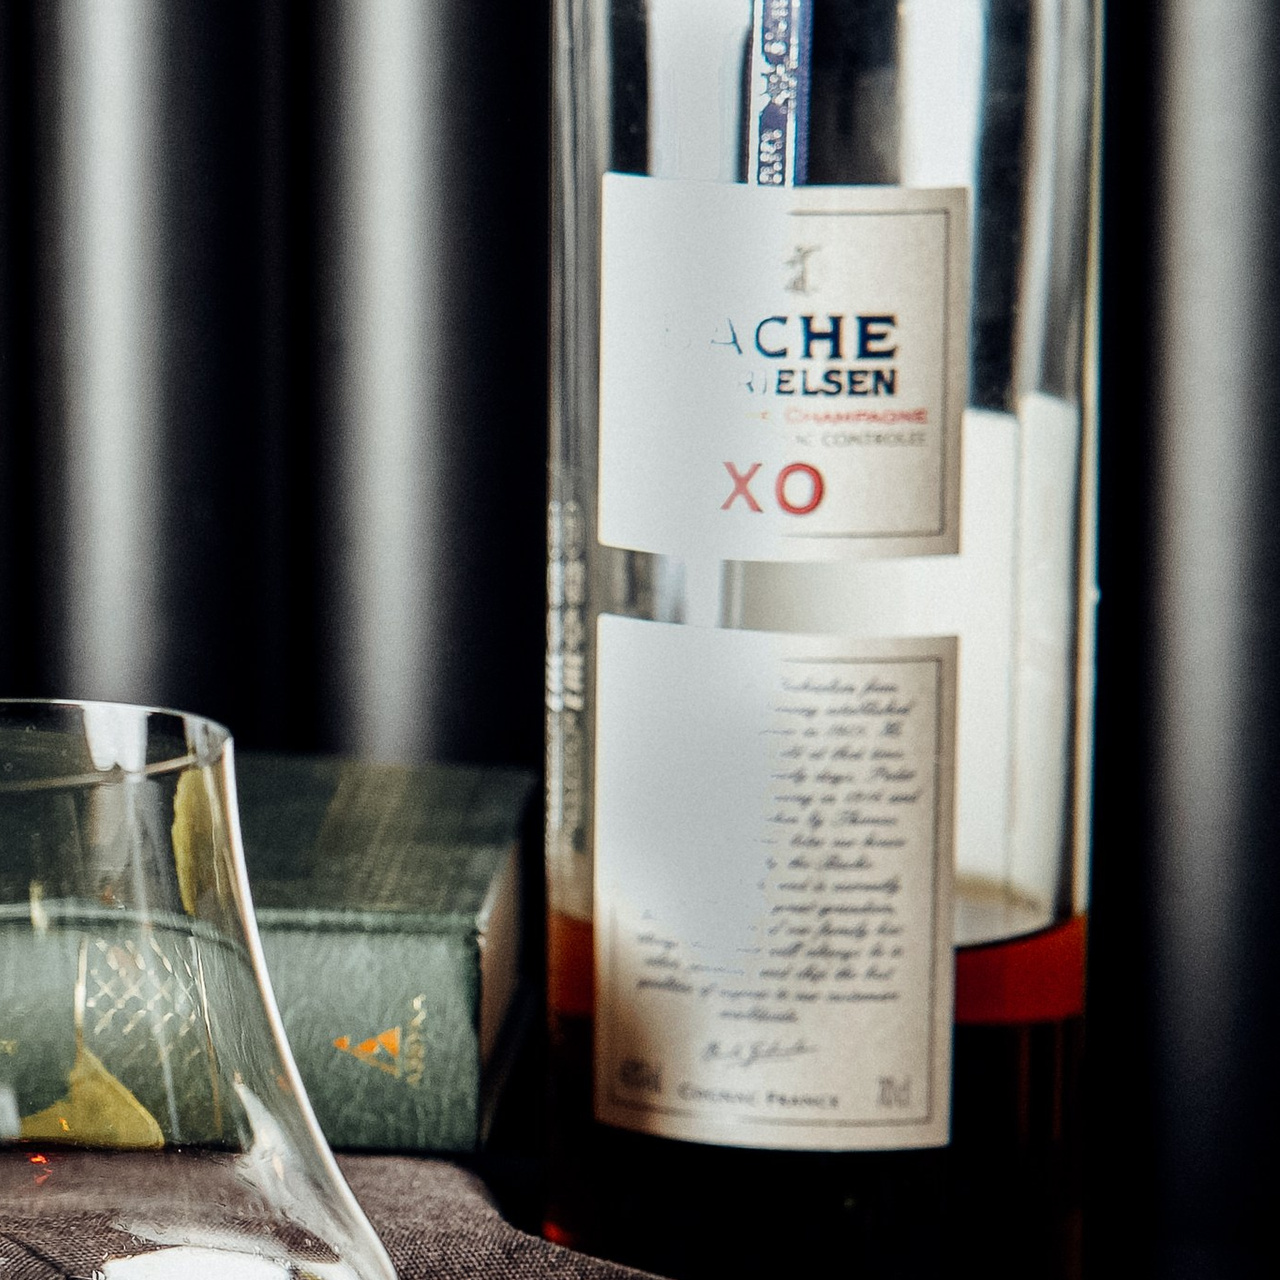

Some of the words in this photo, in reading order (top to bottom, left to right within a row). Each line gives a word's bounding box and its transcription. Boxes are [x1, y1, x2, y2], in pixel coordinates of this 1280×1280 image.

[711, 315, 898, 359] ACHE
[744, 369, 897, 397] ELSEN
[721, 461, 825, 515] XO
